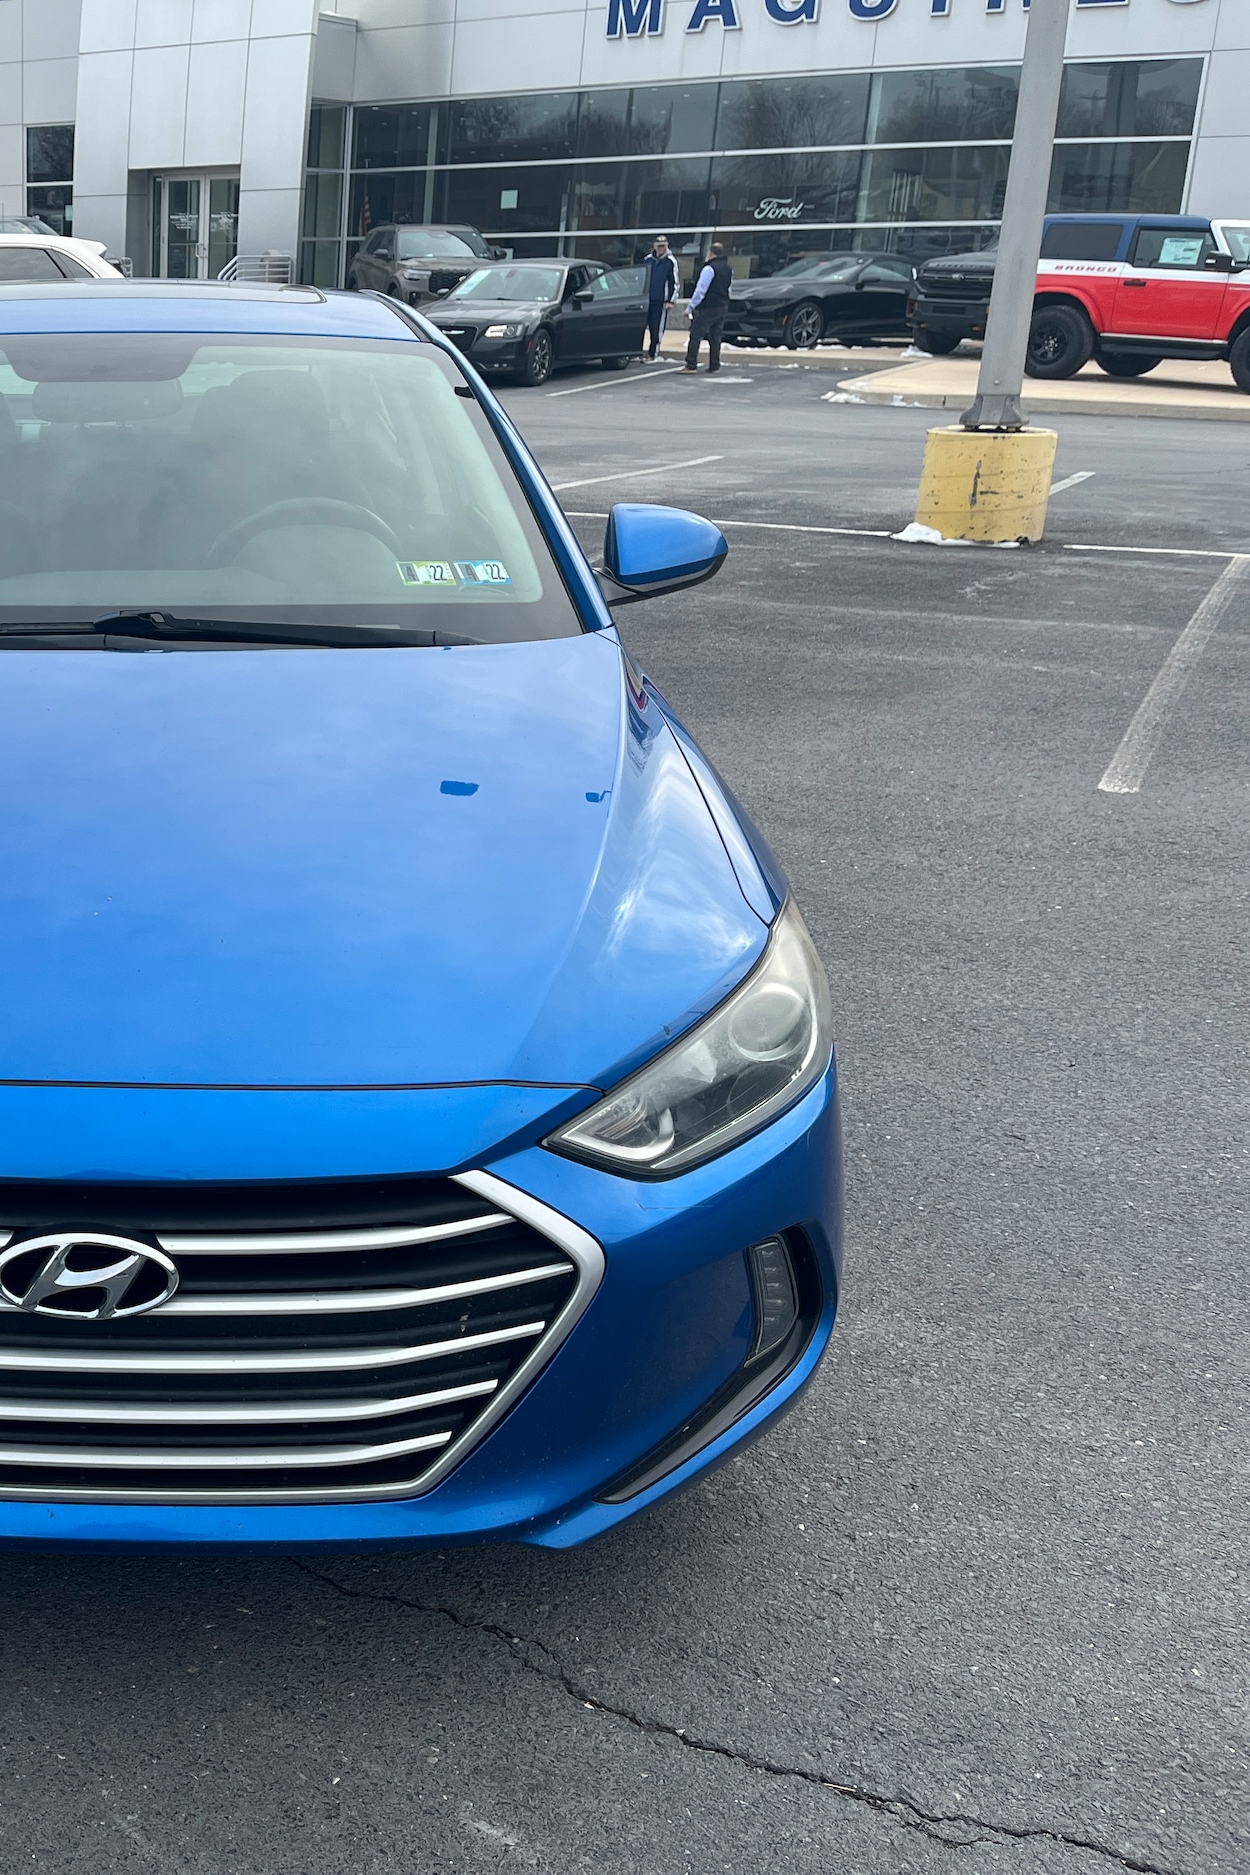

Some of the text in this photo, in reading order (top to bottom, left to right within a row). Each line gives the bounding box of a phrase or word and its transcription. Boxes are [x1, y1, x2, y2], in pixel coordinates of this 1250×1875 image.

[753, 198, 804, 219] Ford
[430, 565, 448, 580] 22
[486, 564, 505, 580] 22
